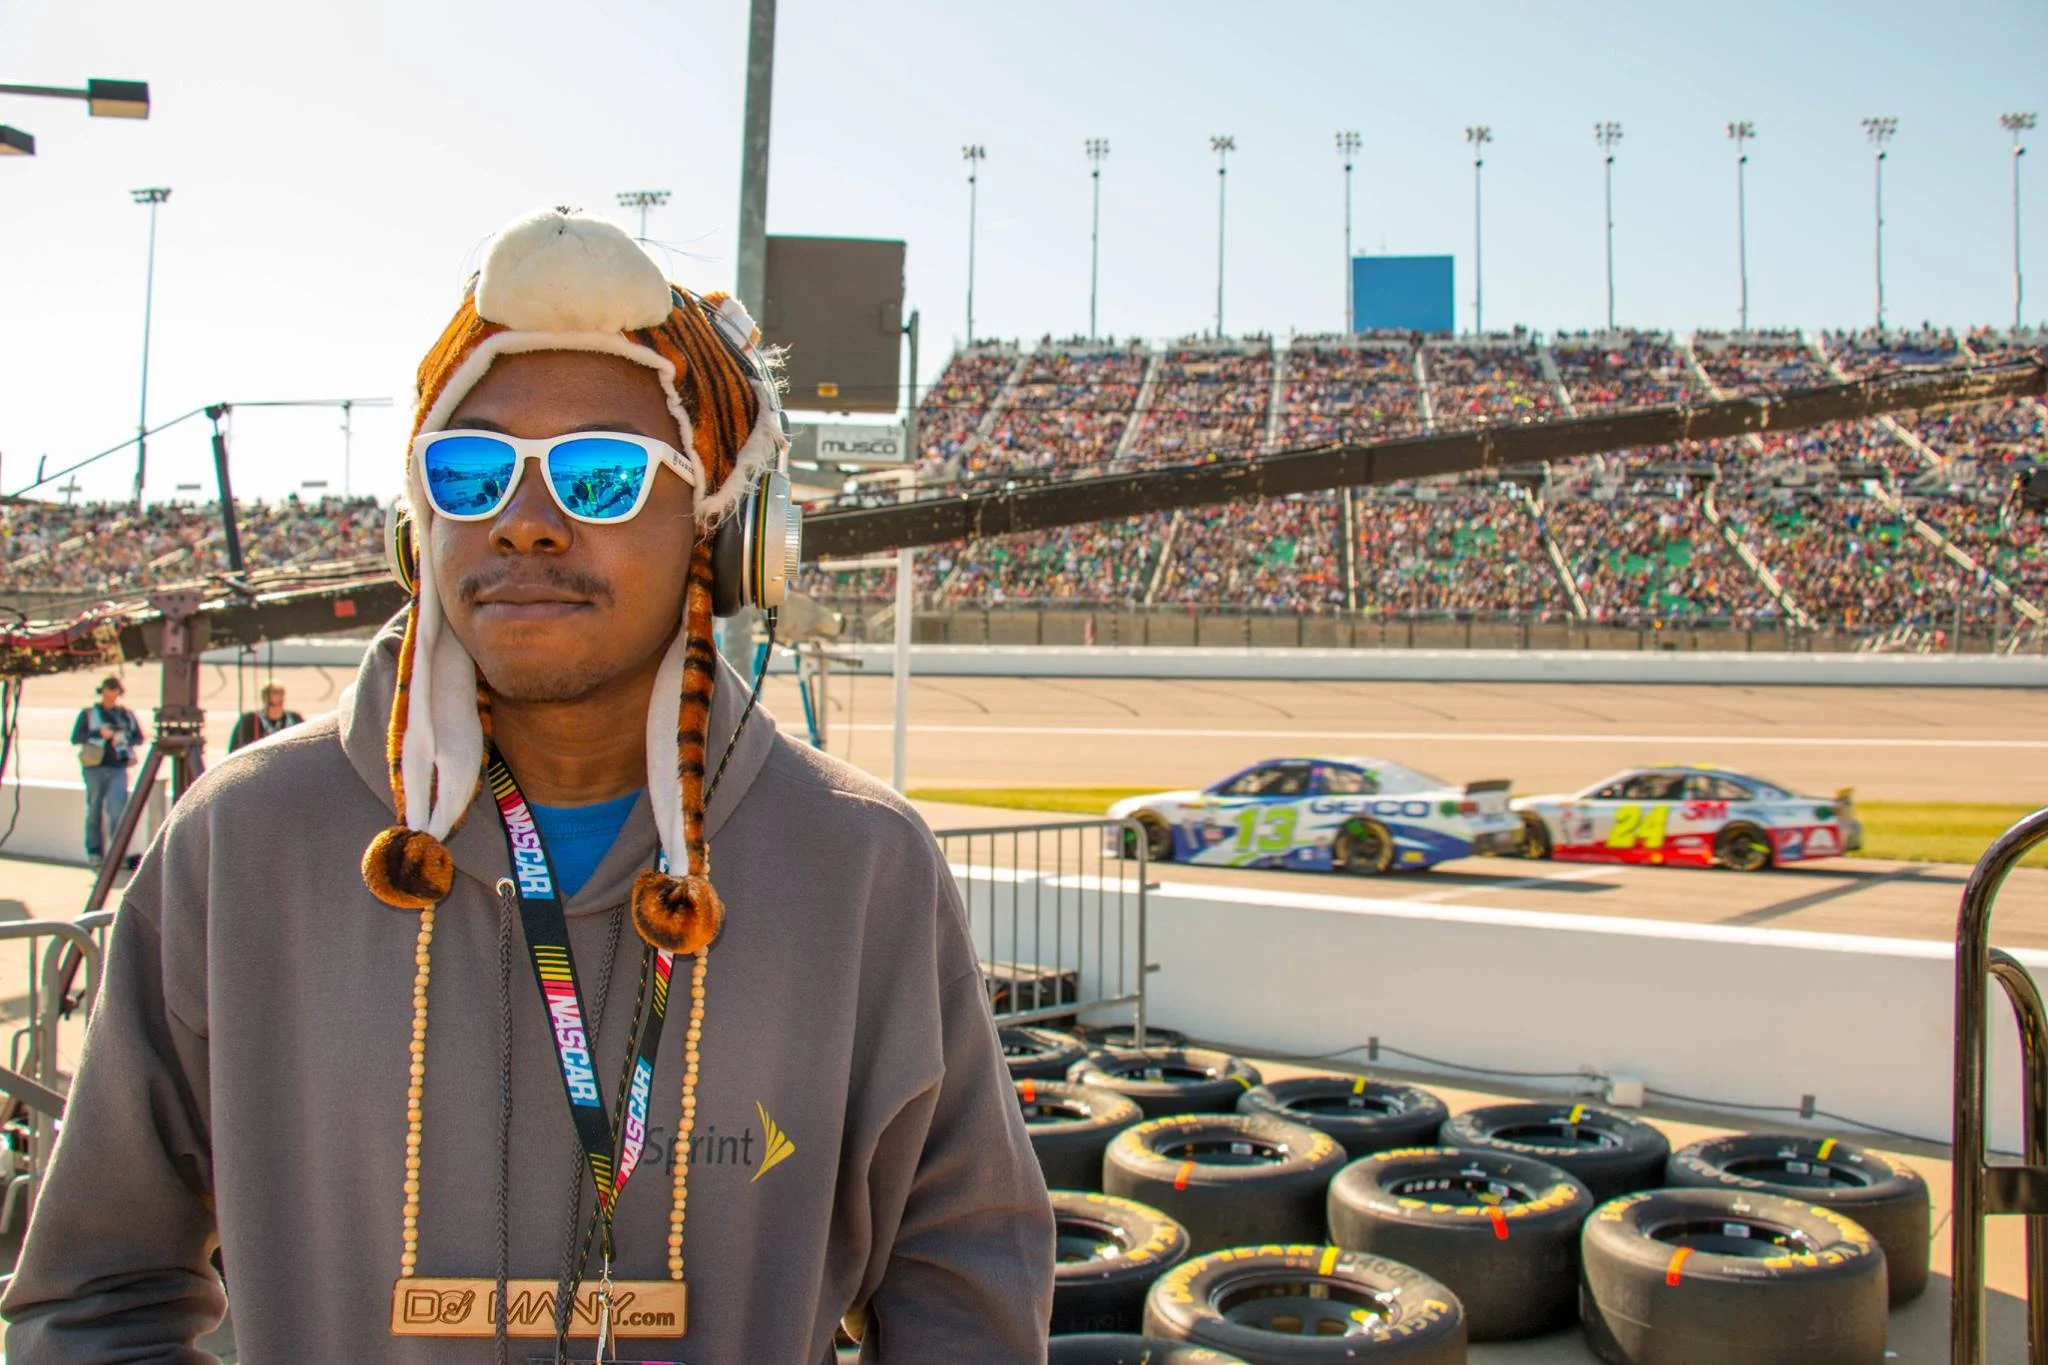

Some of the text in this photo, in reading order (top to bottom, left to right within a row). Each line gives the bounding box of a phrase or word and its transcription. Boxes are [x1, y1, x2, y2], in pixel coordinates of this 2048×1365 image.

[822, 440, 897, 454] musco
[1234, 806, 1298, 852] 13
[1310, 801, 1430, 817] GEICO
[1606, 804, 1669, 848] 24
[504, 803, 550, 894] NASCAR
[547, 994, 598, 1103] NASCAR
[616, 1064, 652, 1178] NASCAR
